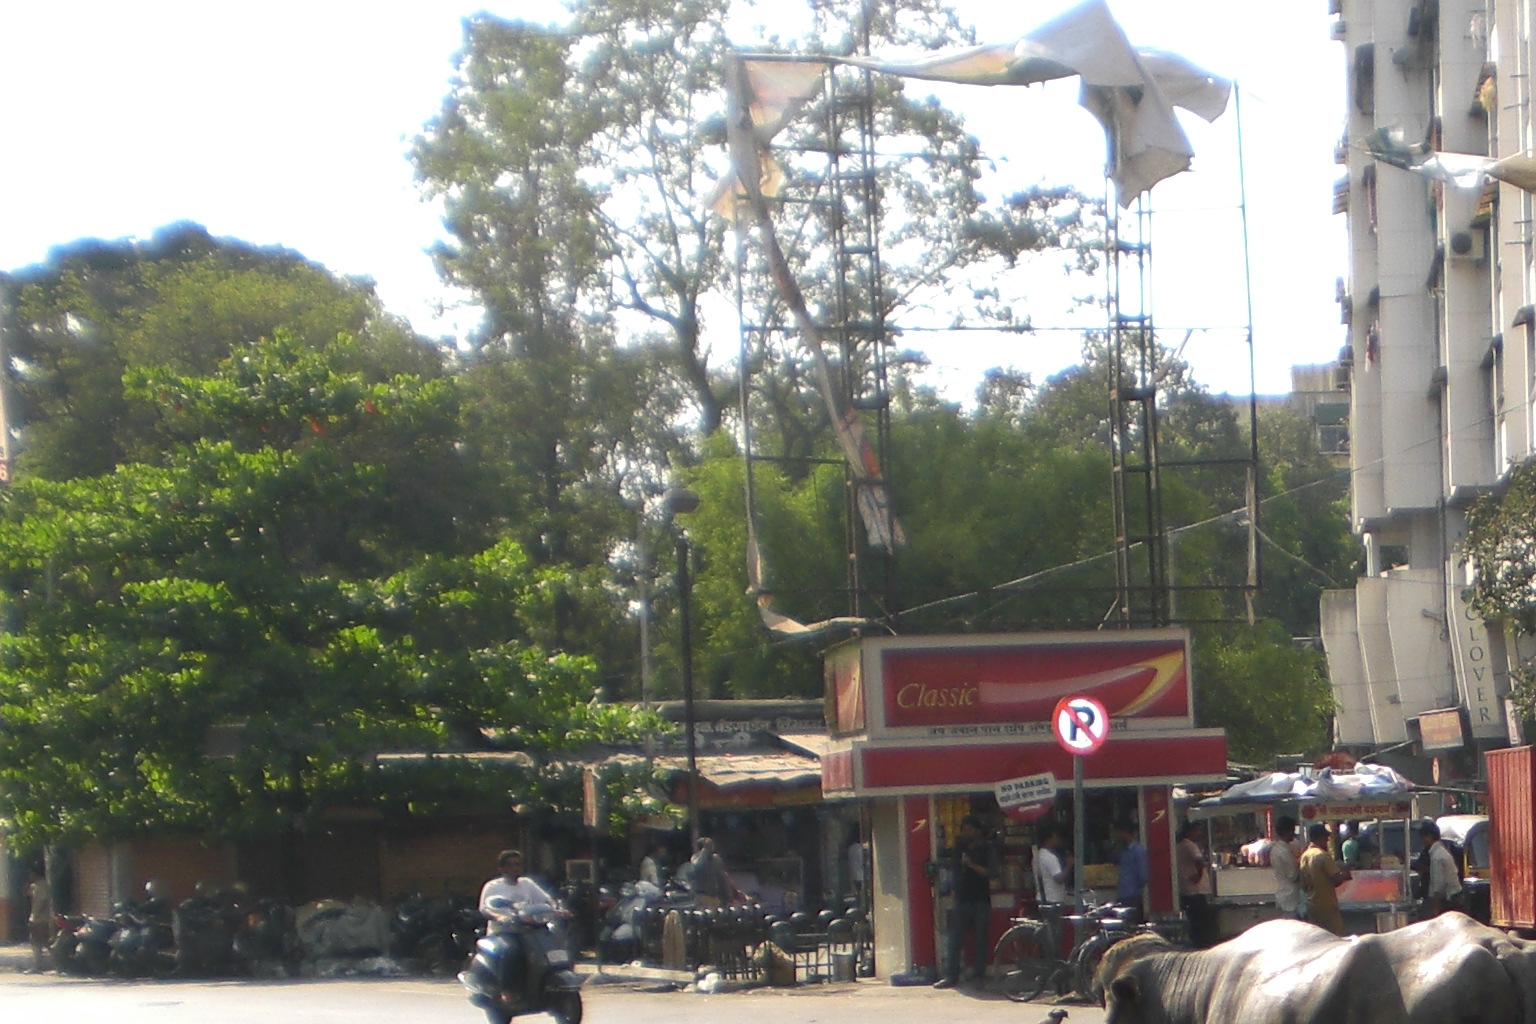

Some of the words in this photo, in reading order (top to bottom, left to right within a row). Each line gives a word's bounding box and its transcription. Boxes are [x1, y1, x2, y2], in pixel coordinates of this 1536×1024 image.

[1465, 604, 1491, 722] CLOVER
[896, 682, 977, 709] Classic
[1001, 783, 1013, 793] NO
[1014, 777, 1050, 791] PARKING
